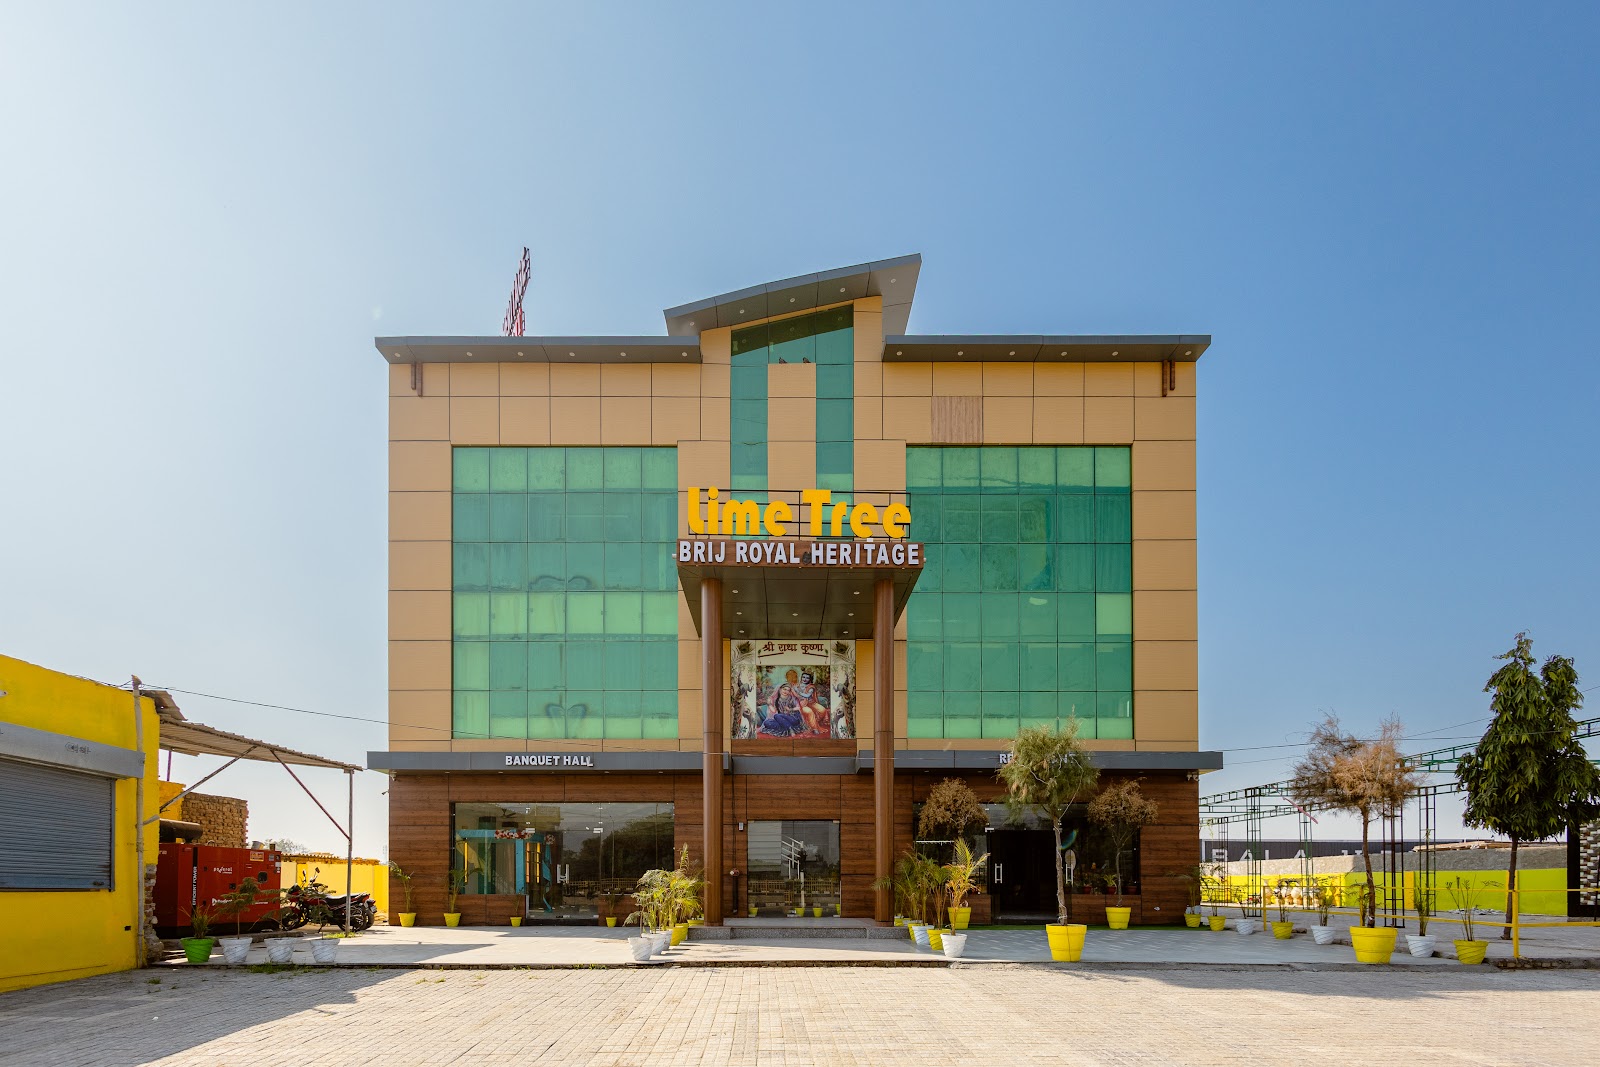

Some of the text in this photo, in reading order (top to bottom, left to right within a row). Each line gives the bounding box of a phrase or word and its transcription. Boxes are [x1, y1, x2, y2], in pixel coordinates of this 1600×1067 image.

[802, 489, 912, 539] Tree
[679, 541, 920, 566] BRIJ ROYAL HERITAGE
[762, 641, 775, 652] श्री
[800, 643, 824, 654] कृष्णा
[505, 755, 594, 767] BANQUET HALL
